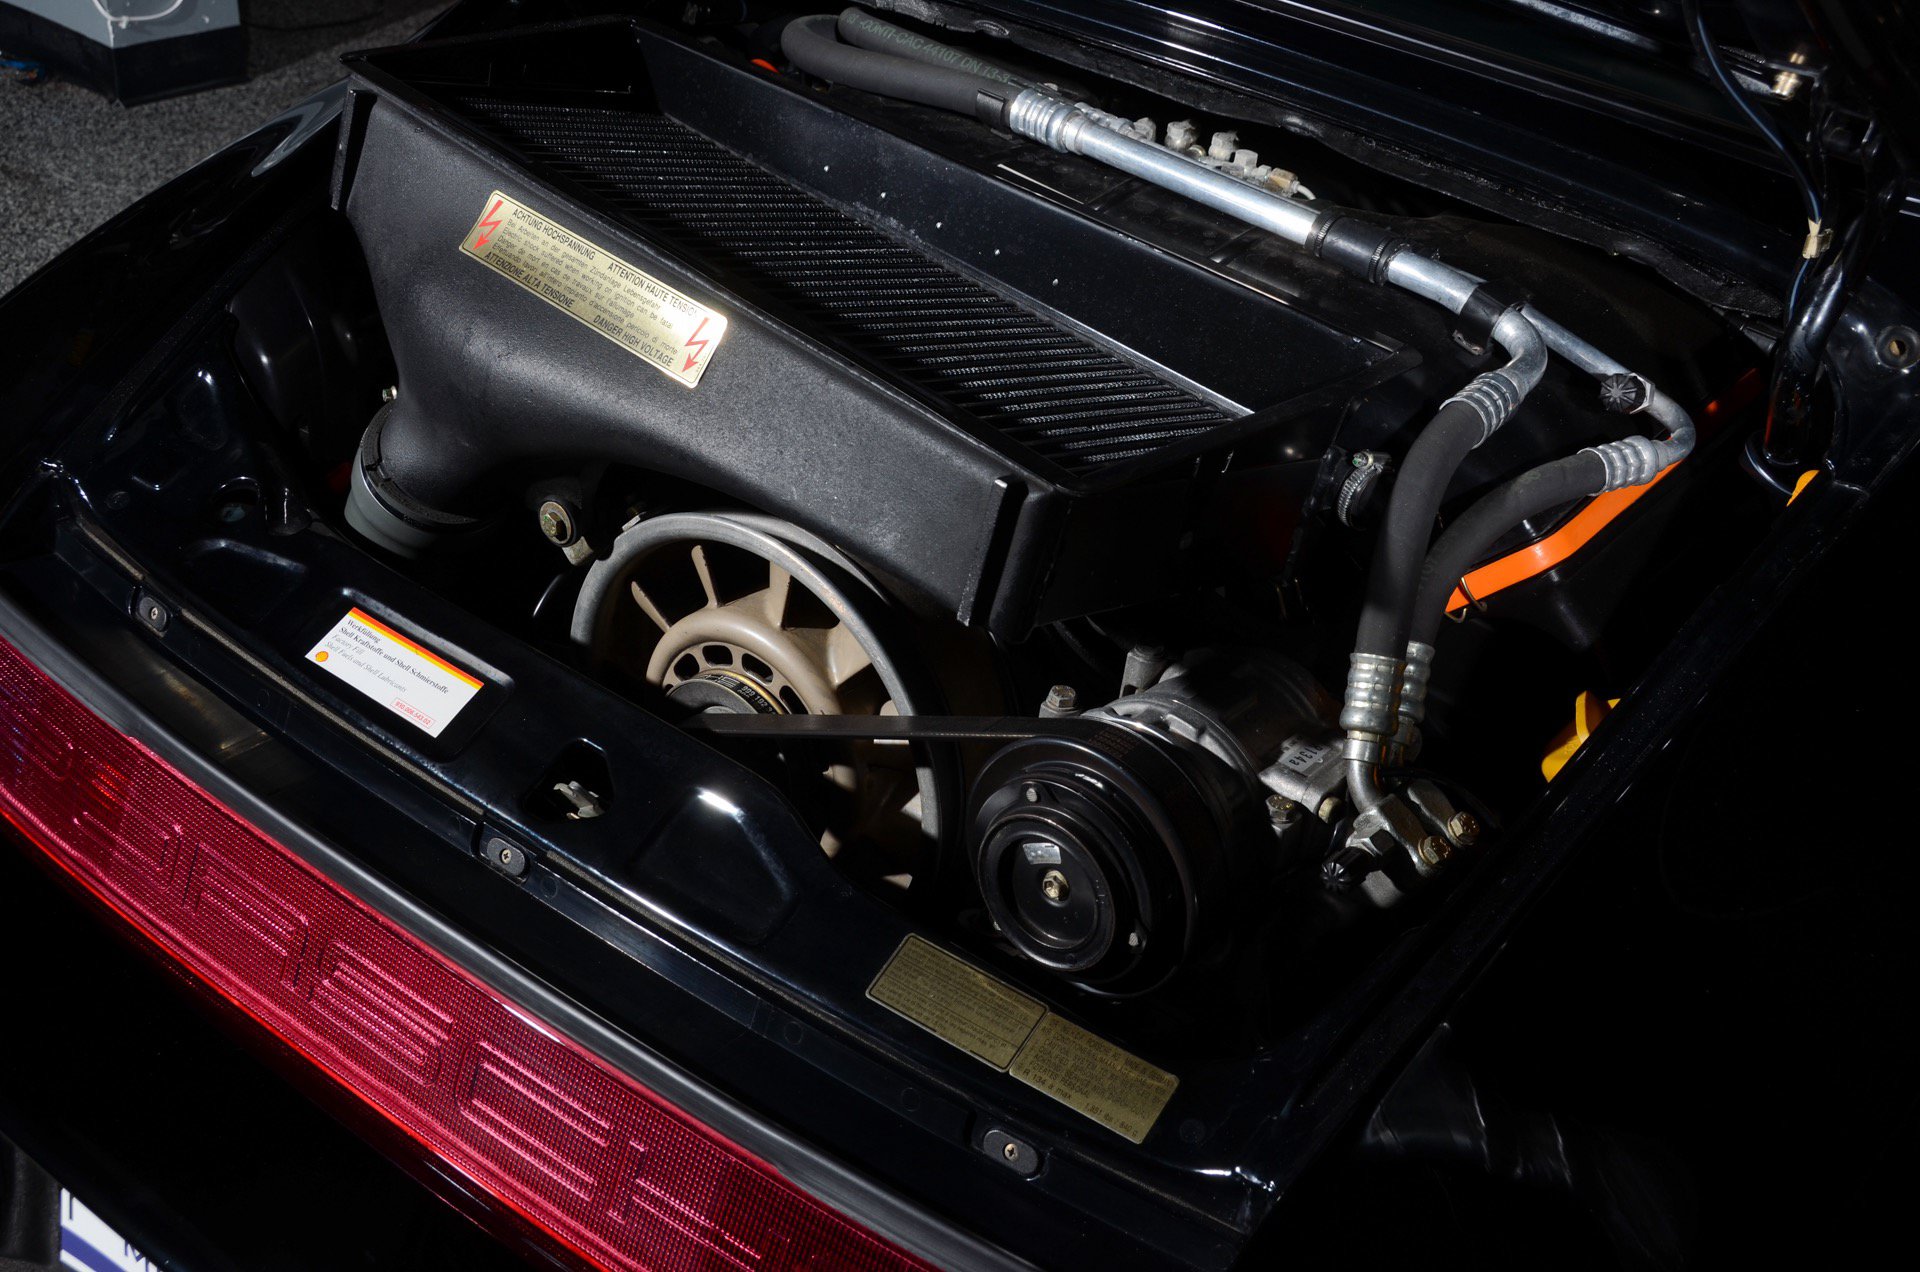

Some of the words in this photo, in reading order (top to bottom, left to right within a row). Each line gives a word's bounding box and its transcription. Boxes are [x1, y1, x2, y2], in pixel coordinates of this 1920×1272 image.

[960, 57, 982, 74] DN
[512, 208, 543, 230] ACHTUNG
[542, 225, 595, 260] HOCHSPANNUNG
[484, 250, 524, 278] ATTENZIONE
[522, 272, 541, 288] ALTA
[541, 283, 574, 308] TENSIONE
[497, 235, 516, 250] Danger
[527, 252, 540, 263] mort
[550, 266, 560, 275] cas
[572, 278, 592, 294] travaux
[595, 292, 604, 300] sur
[502, 227, 522, 241] Electric
[523, 239, 539, 251] shock
[541, 249, 563, 265] suffered
[564, 263, 579, 274] when
[580, 272, 603, 289] working
[613, 291, 635, 308] ignition
[636, 305, 647, 314] can
[649, 312, 658, 320] be
[659, 318, 673, 329] fatal
[507, 219, 516, 227] Bei
[518, 225, 540, 241] Arbeiten
[550, 244, 560, 253] der
[561, 250, 588, 270] gesamten
[589, 266, 622, 289] Zündanlage
[622, 285, 661, 311] Lebensgefahr
[607, 262, 645, 288] ATTENTION
[644, 282, 669, 301] HAUTE
[492, 242, 521, 263] Effettuando
[563, 284, 587, 302] impianto
[589, 298, 624, 323] d'accensione
[626, 321, 649, 339] pericolo
[660, 341, 677, 354] morte
[593, 314, 622, 336] DANGER
[622, 331, 640, 347] HIGH
[640, 341, 673, 366] VOLTAGE
[331, 634, 353, 648] Factory
[352, 646, 364, 654] Fill
[346, 619, 381, 643] Werkfüllung
[325, 641, 339, 651] Shell
[337, 648, 354, 660] Fuels
[353, 657, 365, 666] and
[364, 664, 379, 675] Shell
[377, 672, 407, 692] Lubricants
[339, 626, 354, 637] Shell
[353, 634, 385, 655] Kraftstoffe
[383, 653, 396, 662] und
[394, 659, 411, 670] Shell
[409, 667, 450, 694] Schmierstoffe
[1031, 1074, 1047, 1085] 134
